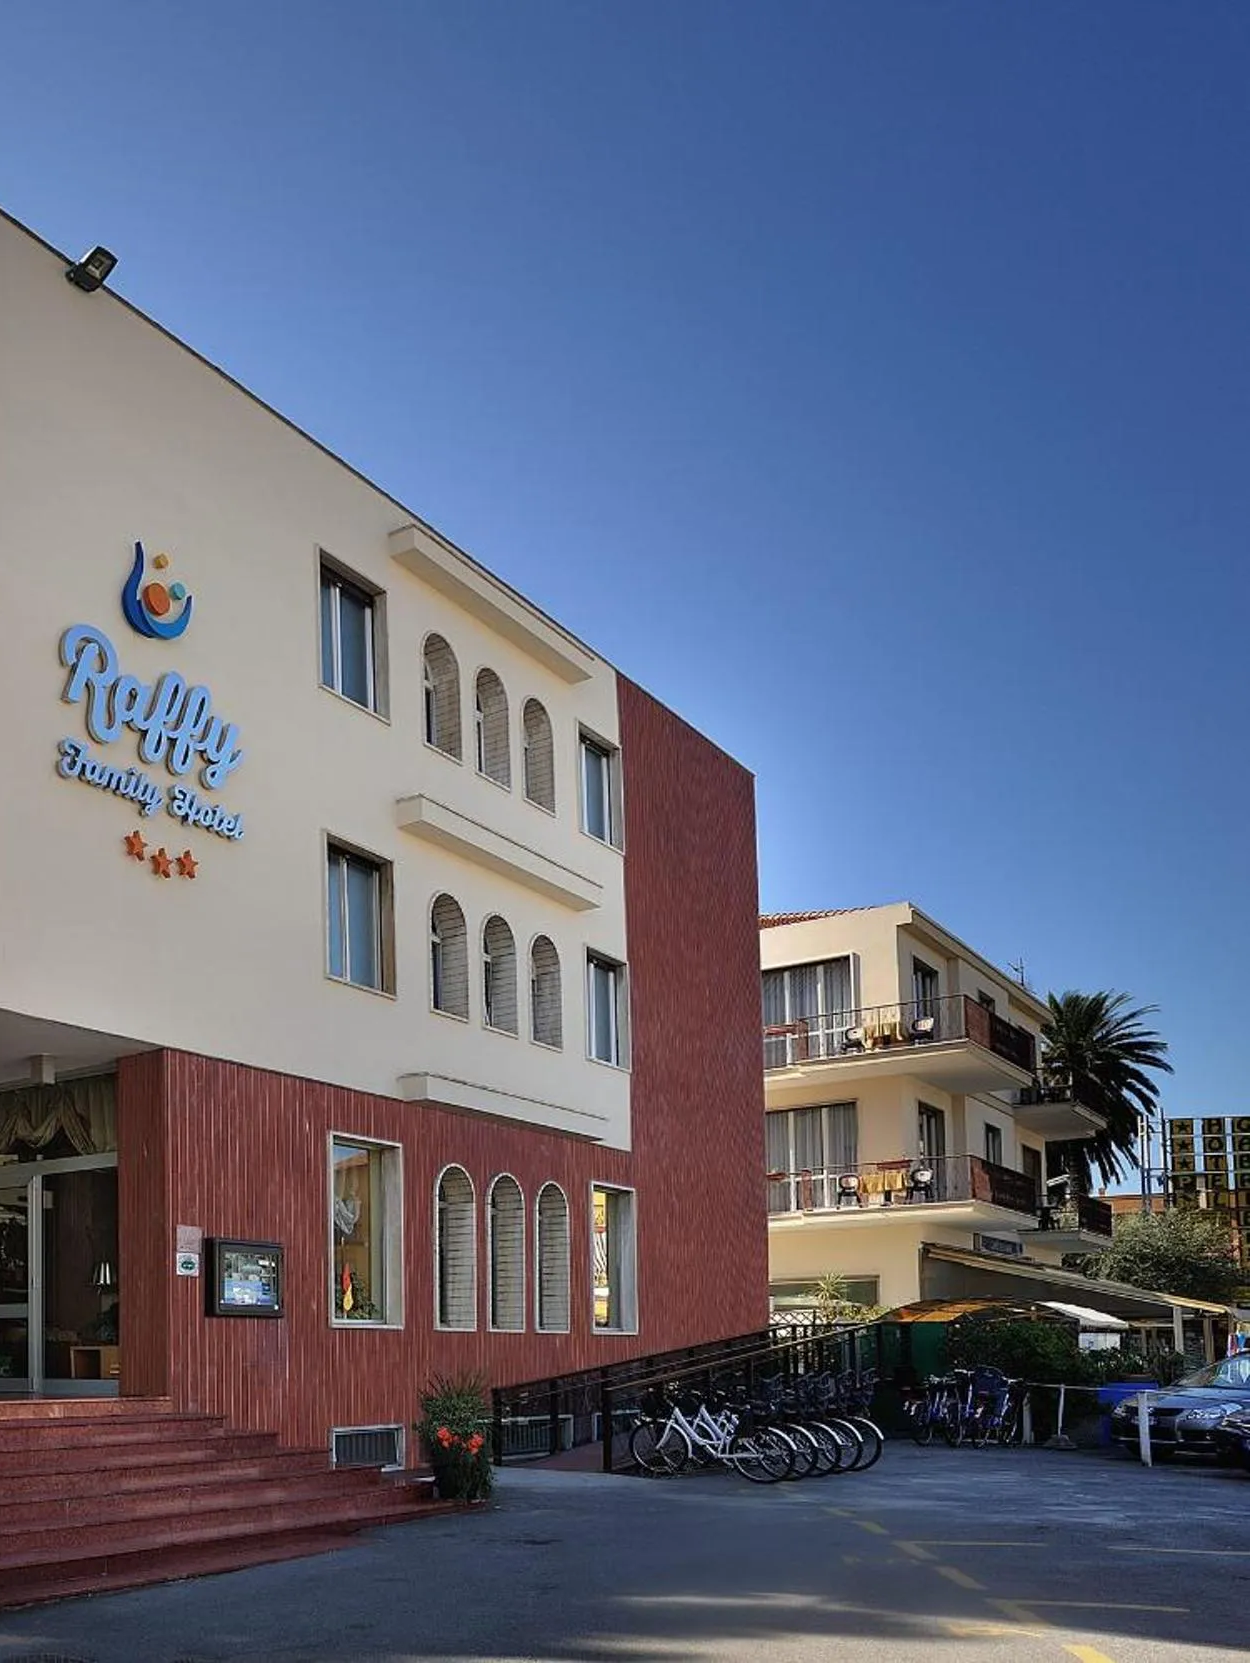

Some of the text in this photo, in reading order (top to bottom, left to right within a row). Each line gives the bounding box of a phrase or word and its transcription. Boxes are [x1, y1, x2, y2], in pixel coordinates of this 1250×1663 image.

[59, 624, 242, 790] Raffy
[56, 736, 244, 840] Family Hotel
